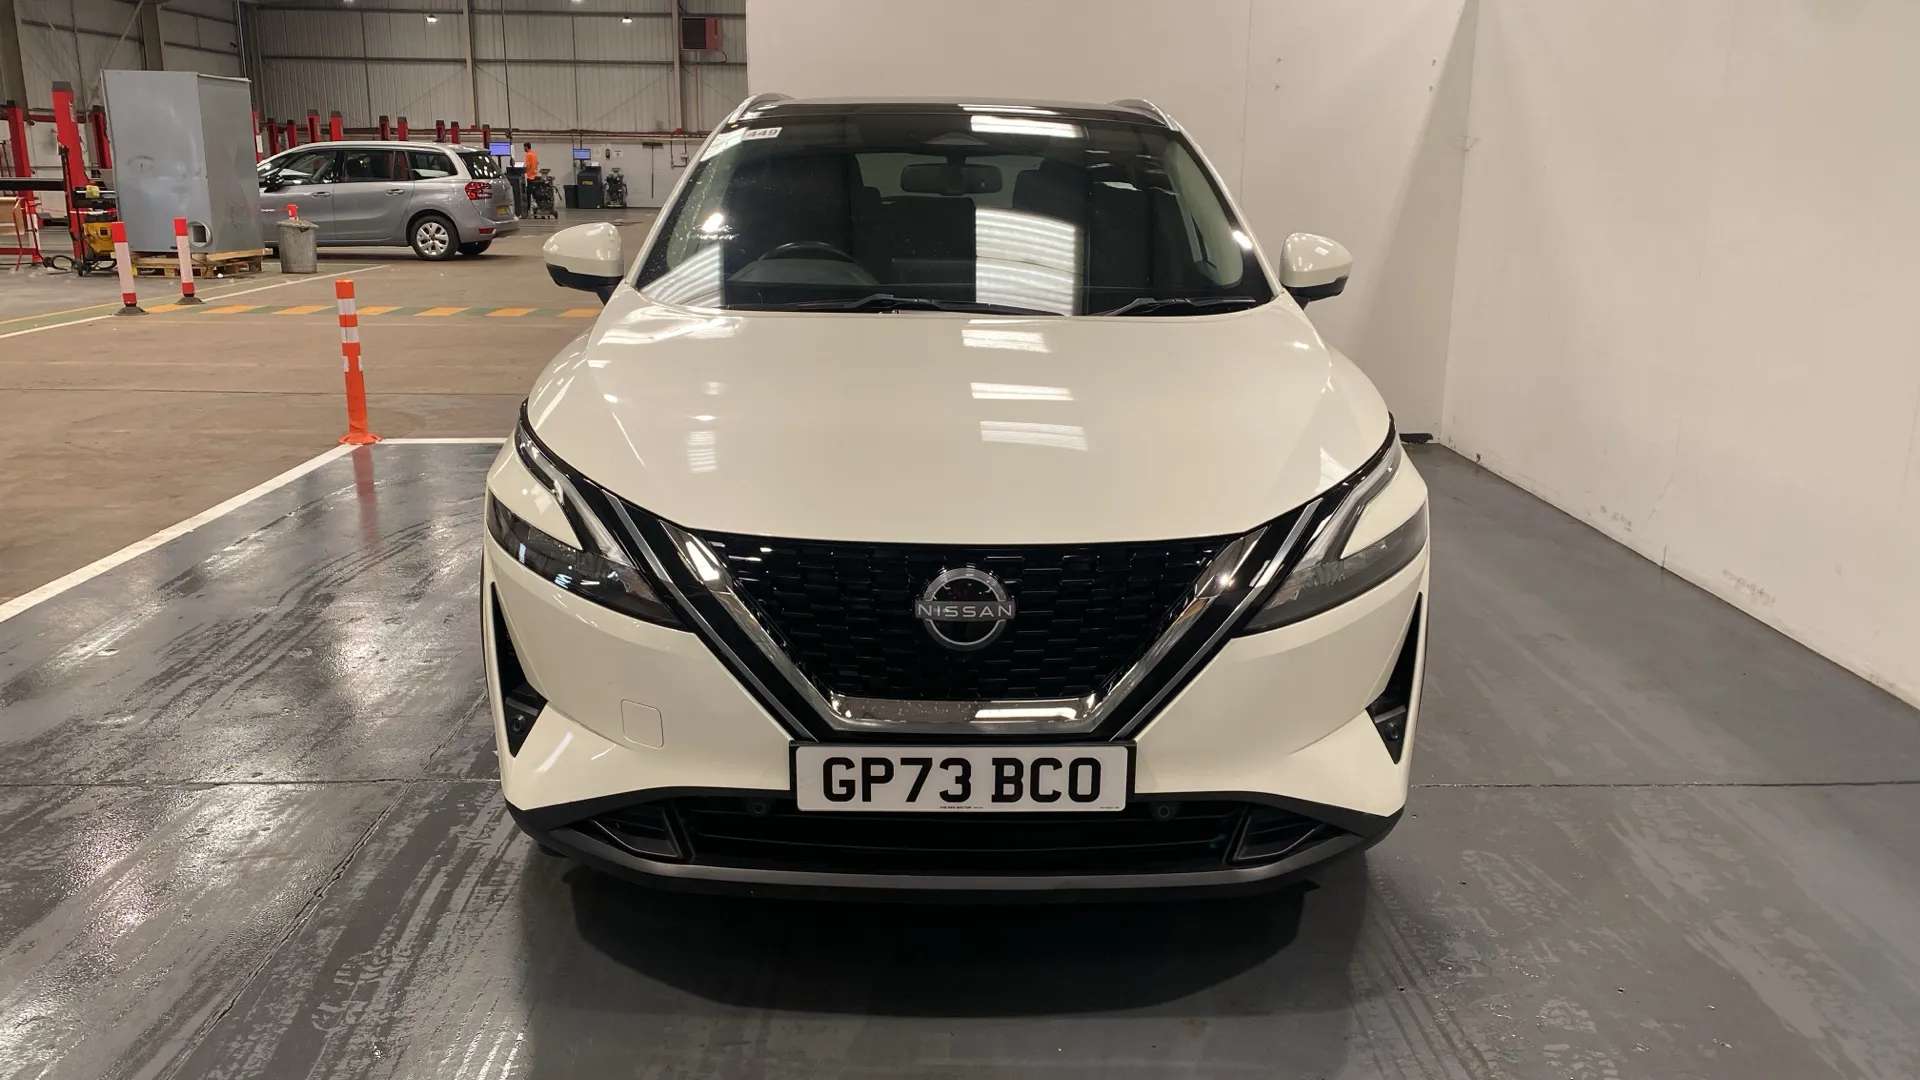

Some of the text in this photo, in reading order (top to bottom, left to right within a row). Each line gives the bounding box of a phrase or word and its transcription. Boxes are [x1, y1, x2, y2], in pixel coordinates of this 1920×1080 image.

[918, 603, 1012, 618] NISSAN
[822, 756, 1102, 803] GP73 BCO
